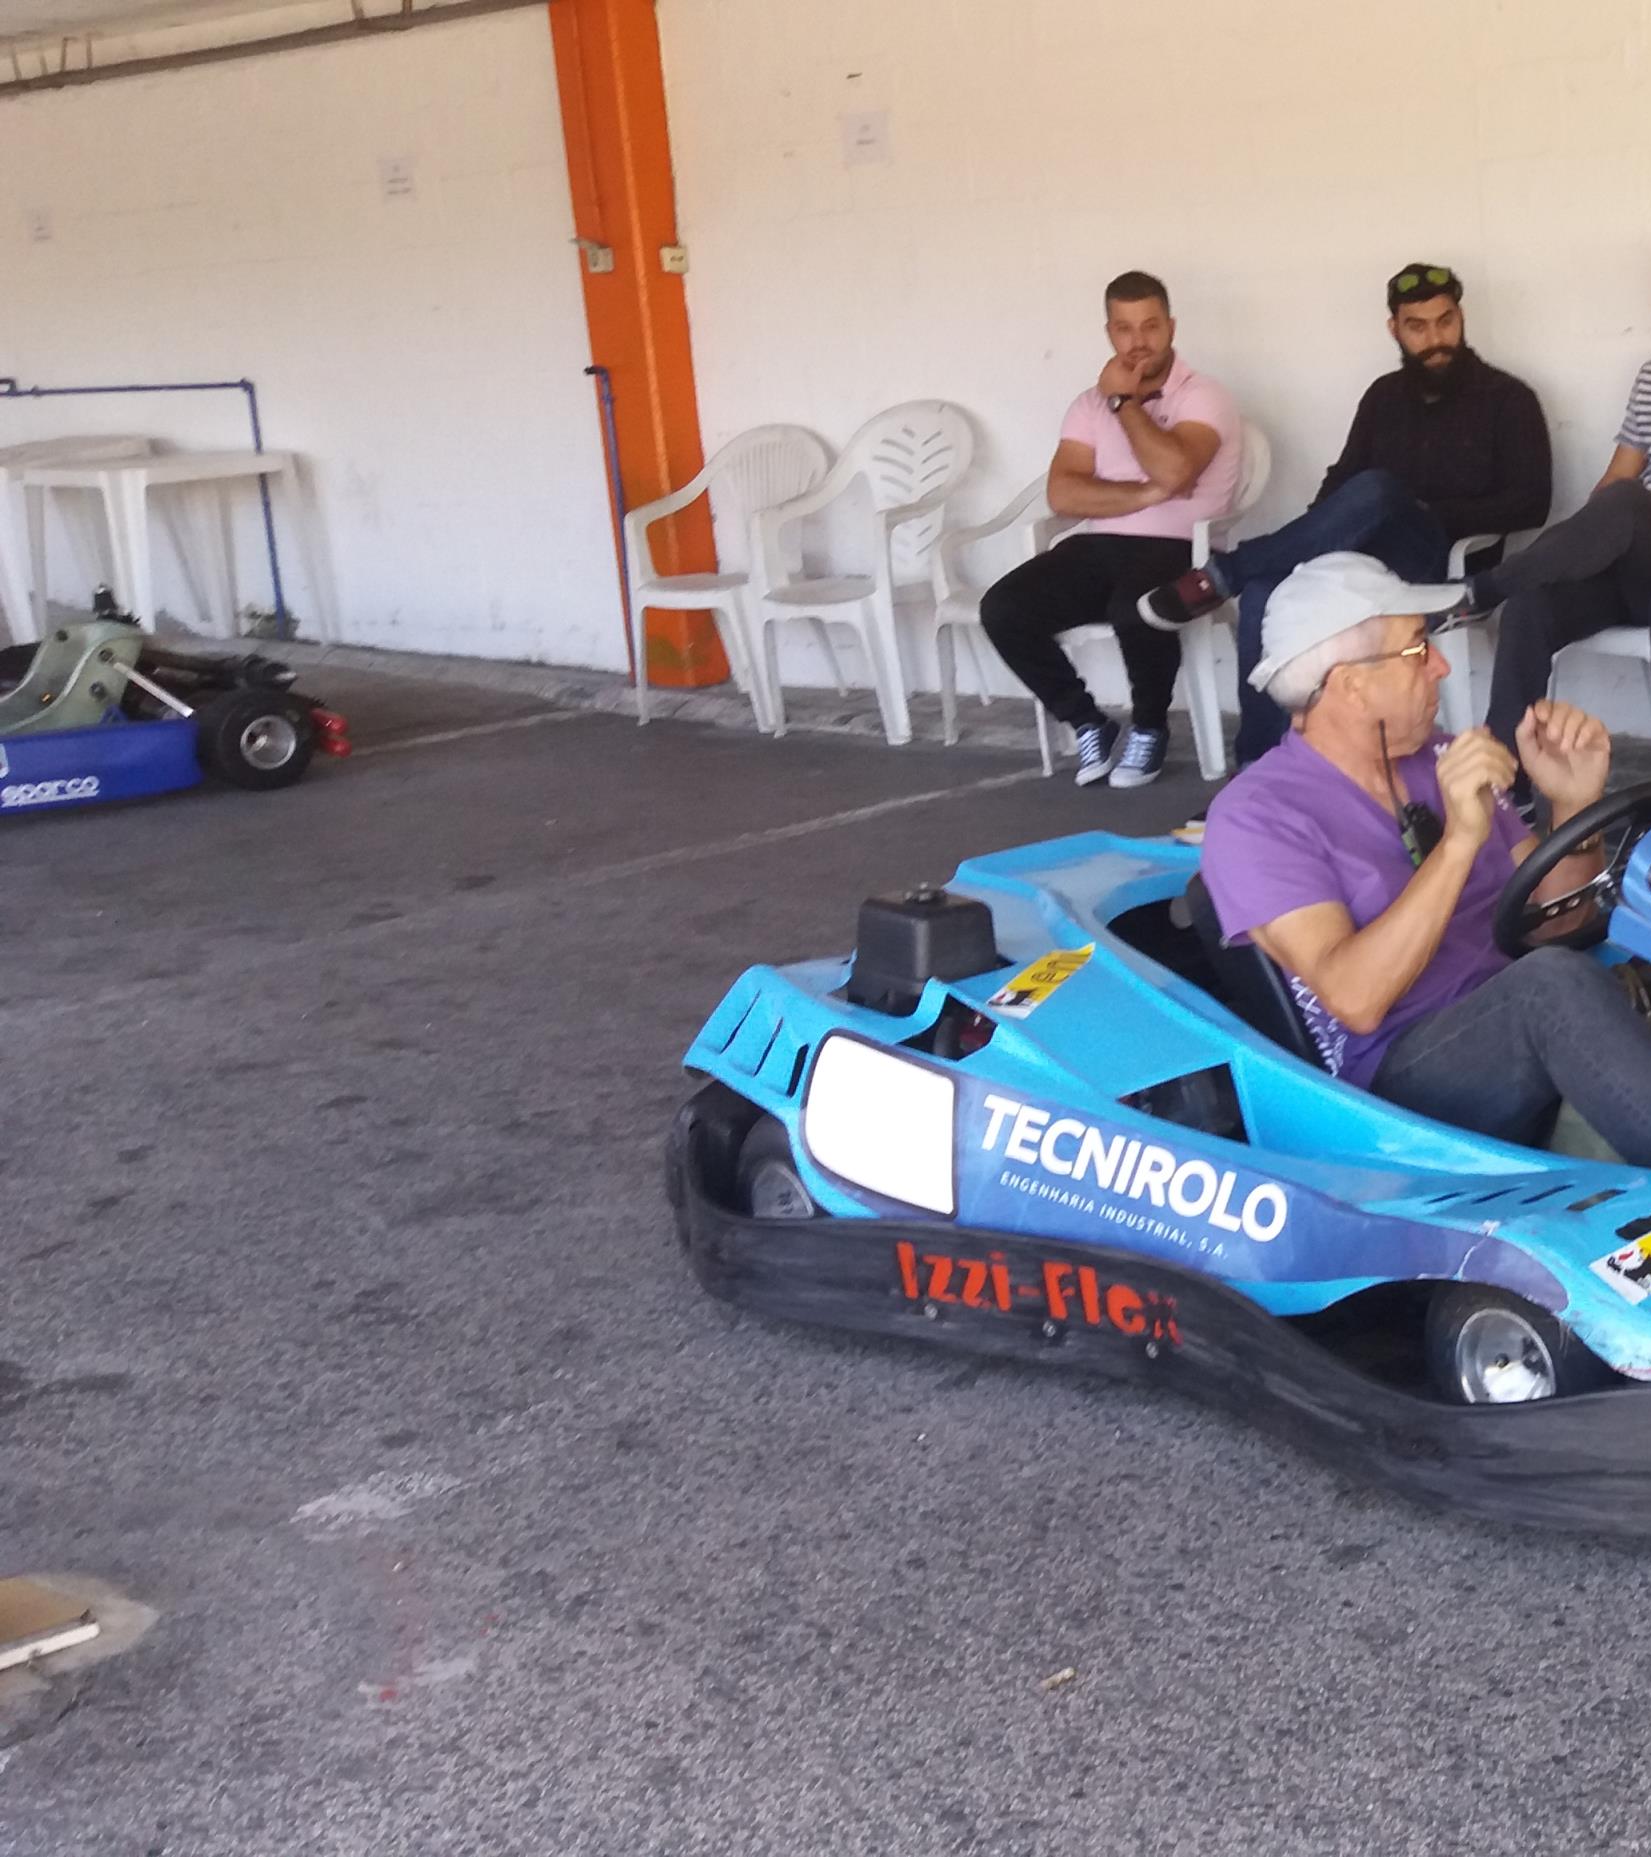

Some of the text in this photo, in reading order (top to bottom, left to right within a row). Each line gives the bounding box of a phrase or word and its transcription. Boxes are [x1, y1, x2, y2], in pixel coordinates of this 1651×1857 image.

[1, 775, 100, 808] sparco
[981, 1093, 1288, 1242] TECNIROLO
[1000, 1170, 1095, 1214] ENGENHARIA
